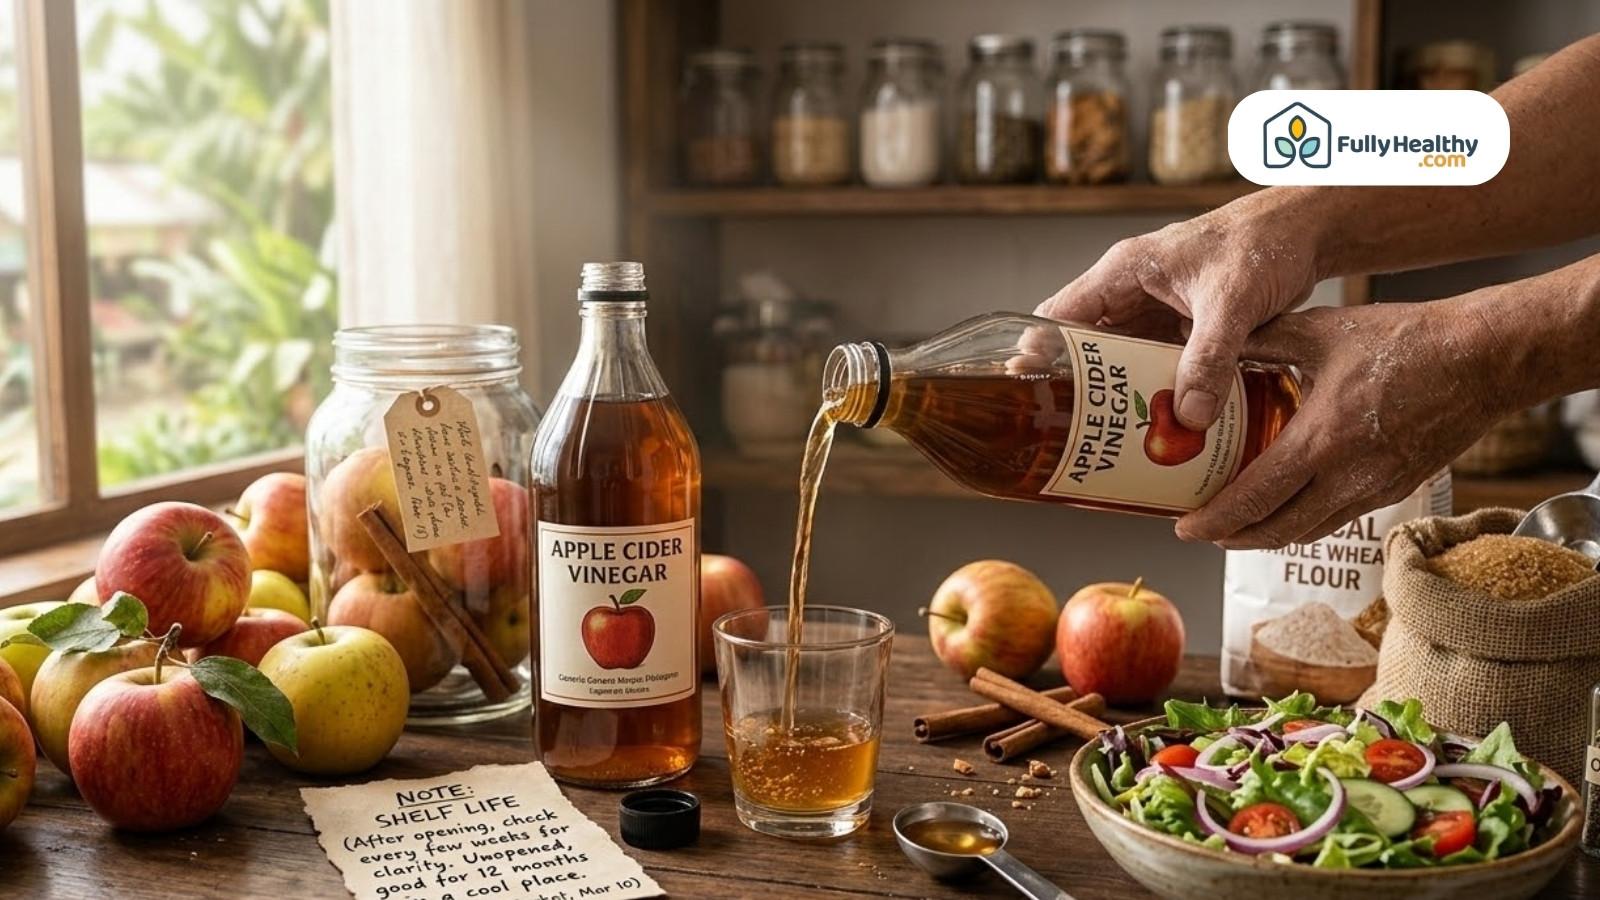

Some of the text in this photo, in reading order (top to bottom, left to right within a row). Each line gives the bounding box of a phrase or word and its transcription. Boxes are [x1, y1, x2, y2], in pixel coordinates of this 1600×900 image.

[1068, 341, 1106, 484] APPLE CIDER
[1095, 365, 1129, 472] VINEGAR
[551, 537, 683, 560] APPLE CIDER
[1327, 544, 1384, 565] WHEA
[568, 563, 668, 584] VINEGAR
[1284, 562, 1361, 590] FLOUR
[396, 784, 475, 807] NOTE:
[375, 795, 520, 829] SHELF LIFE
[343, 809, 559, 852] (After opening, check
[360, 824, 570, 864] every few weeks for
[373, 860, 454, 878] clarity.
[376, 853, 589, 900] good for 12 months
[466, 880, 510, 897] cool
[521, 872, 586, 892] place.
[579, 885, 611, 897] Mar
[616, 877, 641, 890] 10)
